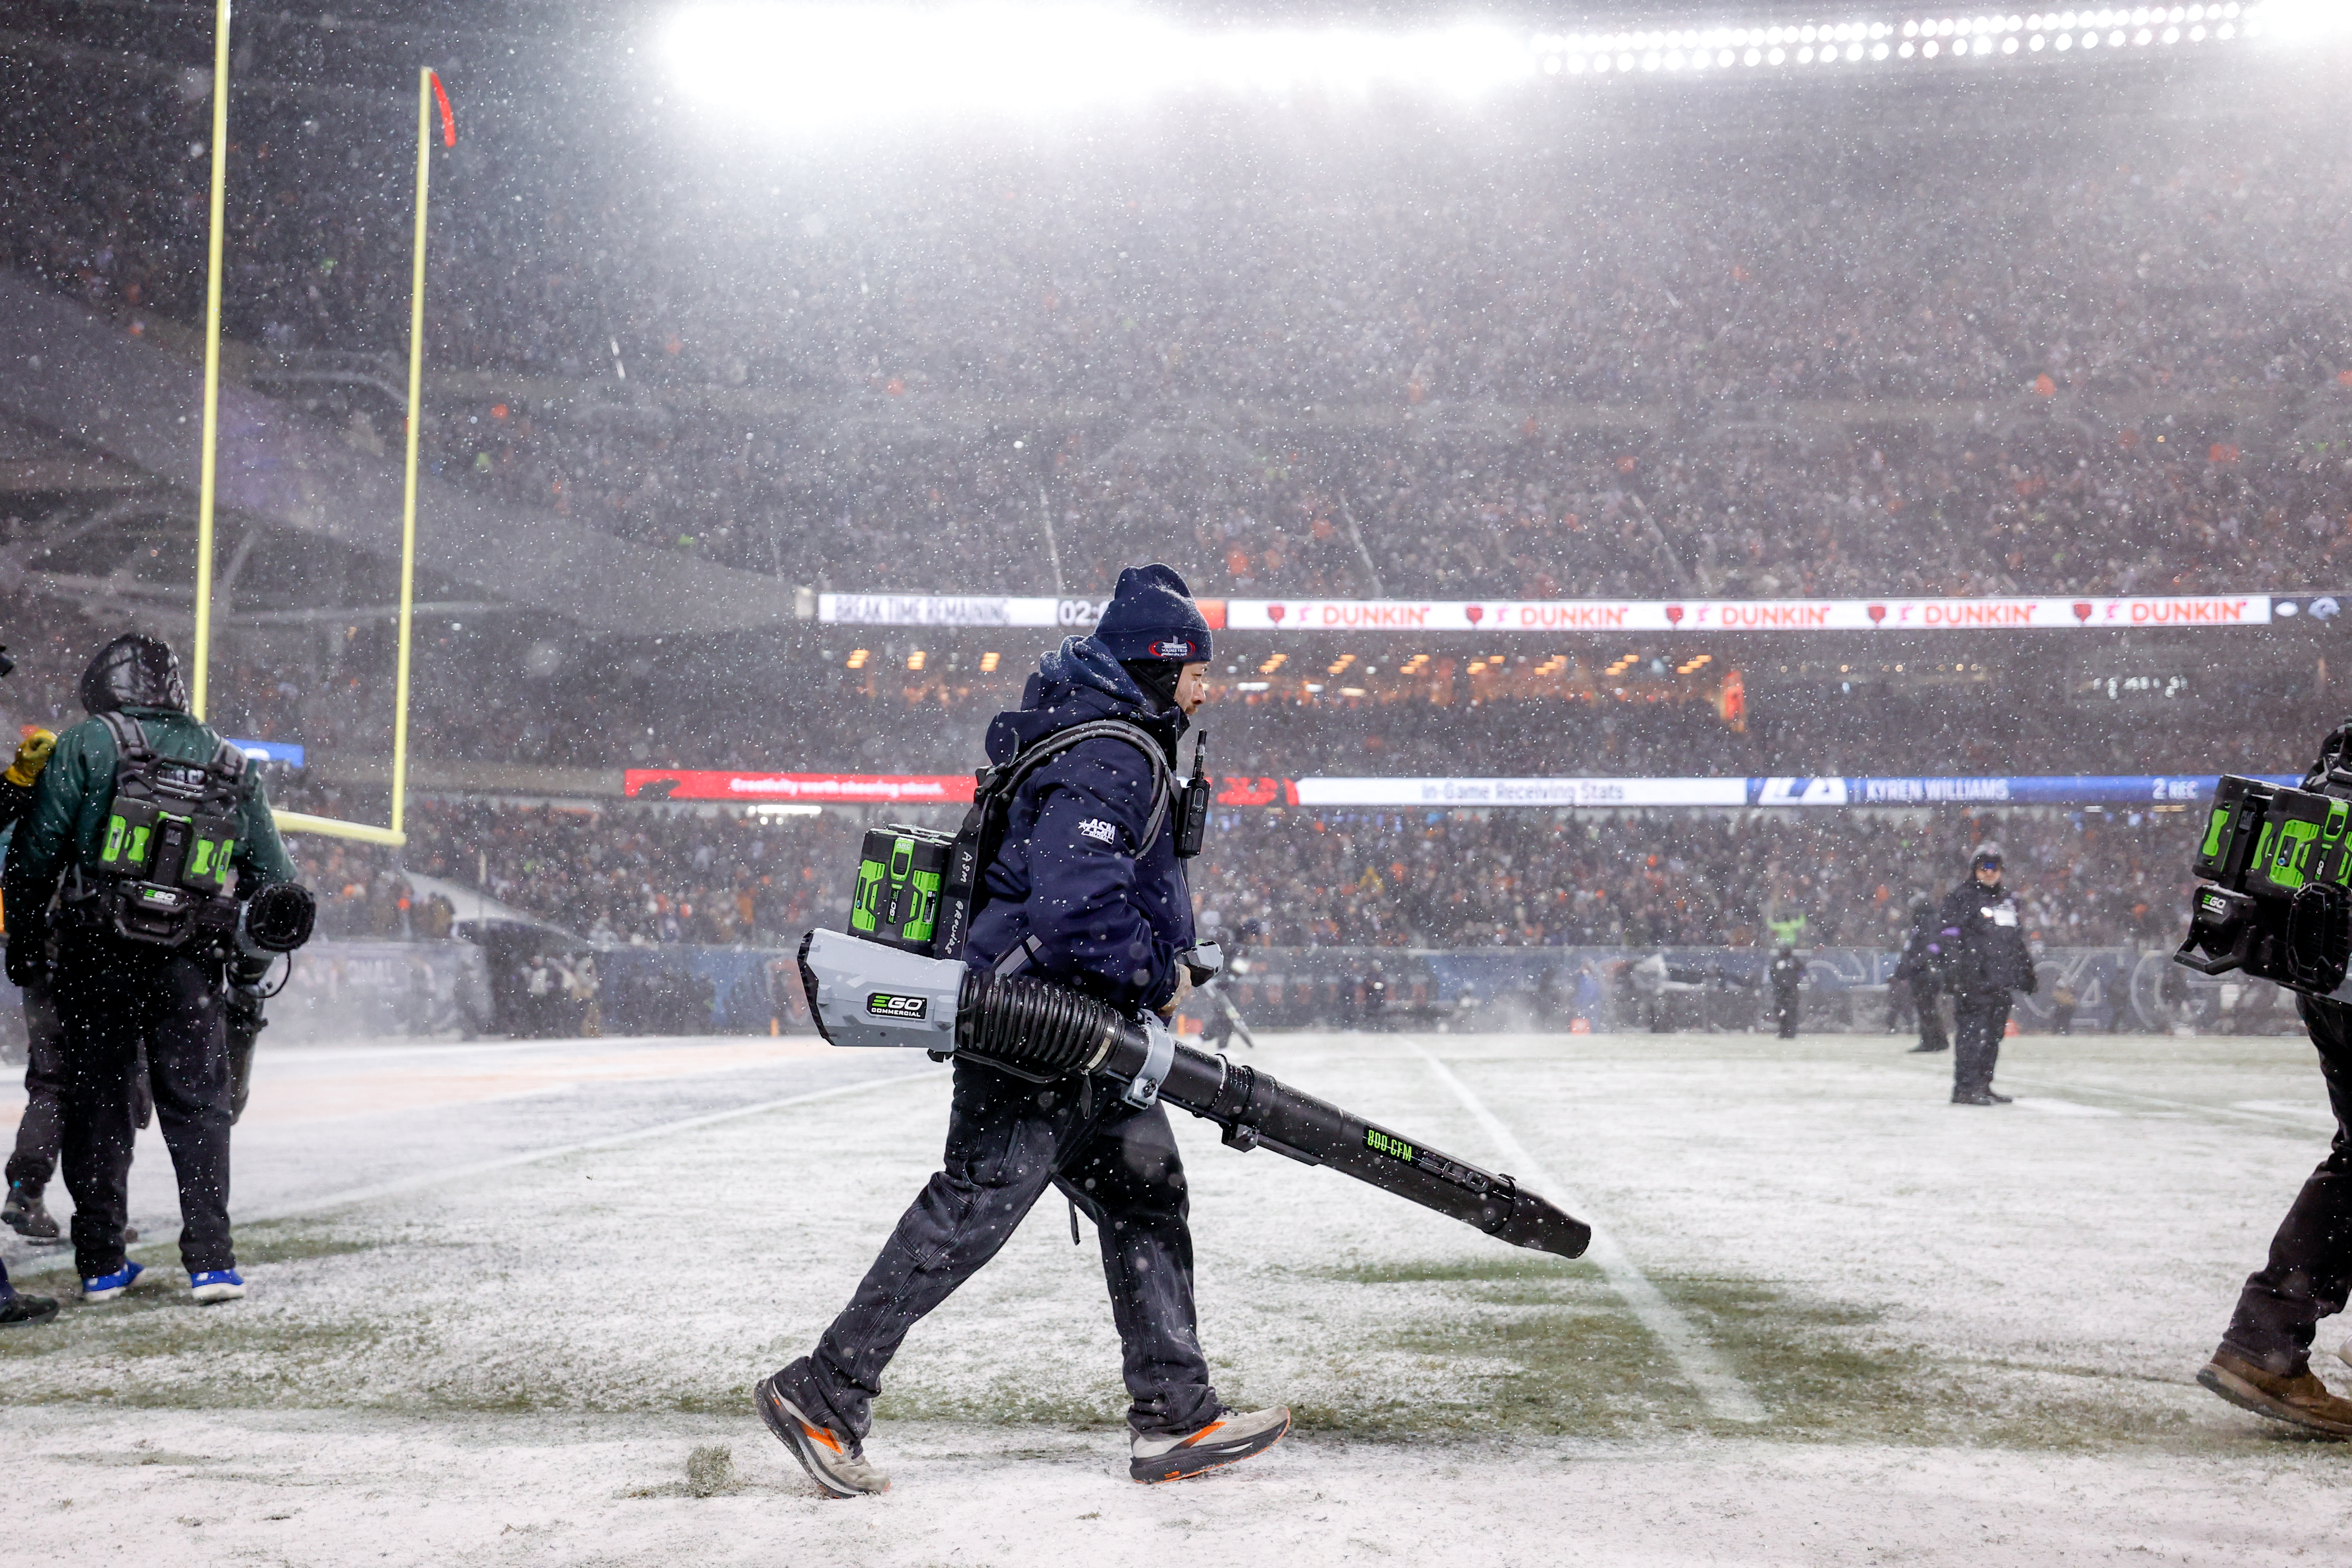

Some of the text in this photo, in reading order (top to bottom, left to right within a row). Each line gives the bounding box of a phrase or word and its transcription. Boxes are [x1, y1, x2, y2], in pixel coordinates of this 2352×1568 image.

[1085, 818, 1116, 839] ASM
[1089, 831, 1110, 842] GLOBAL
[2202, 893, 2227, 909] EGO
[888, 901, 896, 923] EGO
[872, 995, 923, 1010] EGO
[871, 1007, 921, 1017] COMMERCIAL
[1367, 1129, 1412, 1162] 800 CFM
